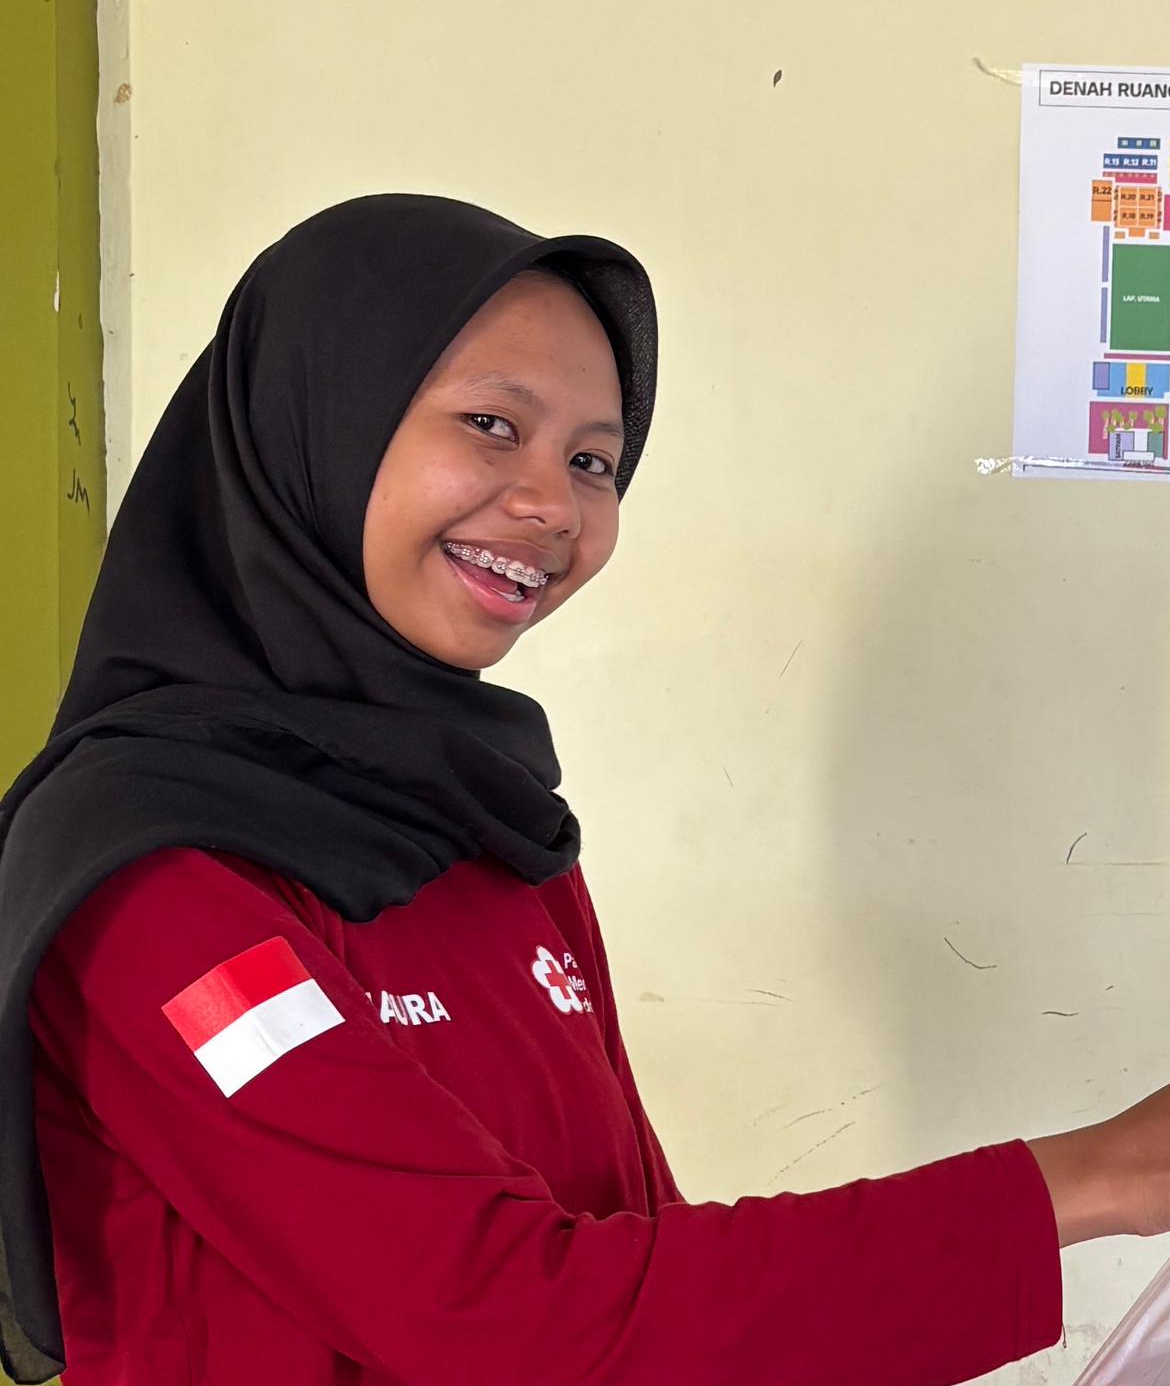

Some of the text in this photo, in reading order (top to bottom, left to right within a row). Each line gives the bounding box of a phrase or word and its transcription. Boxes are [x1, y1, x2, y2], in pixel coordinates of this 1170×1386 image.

[1049, 81, 1112, 97] DENAH
[1092, 186, 1112, 195] R.22
[1121, 387, 1153, 395] LOBBY
[364, 990, 452, 1026] AURA
